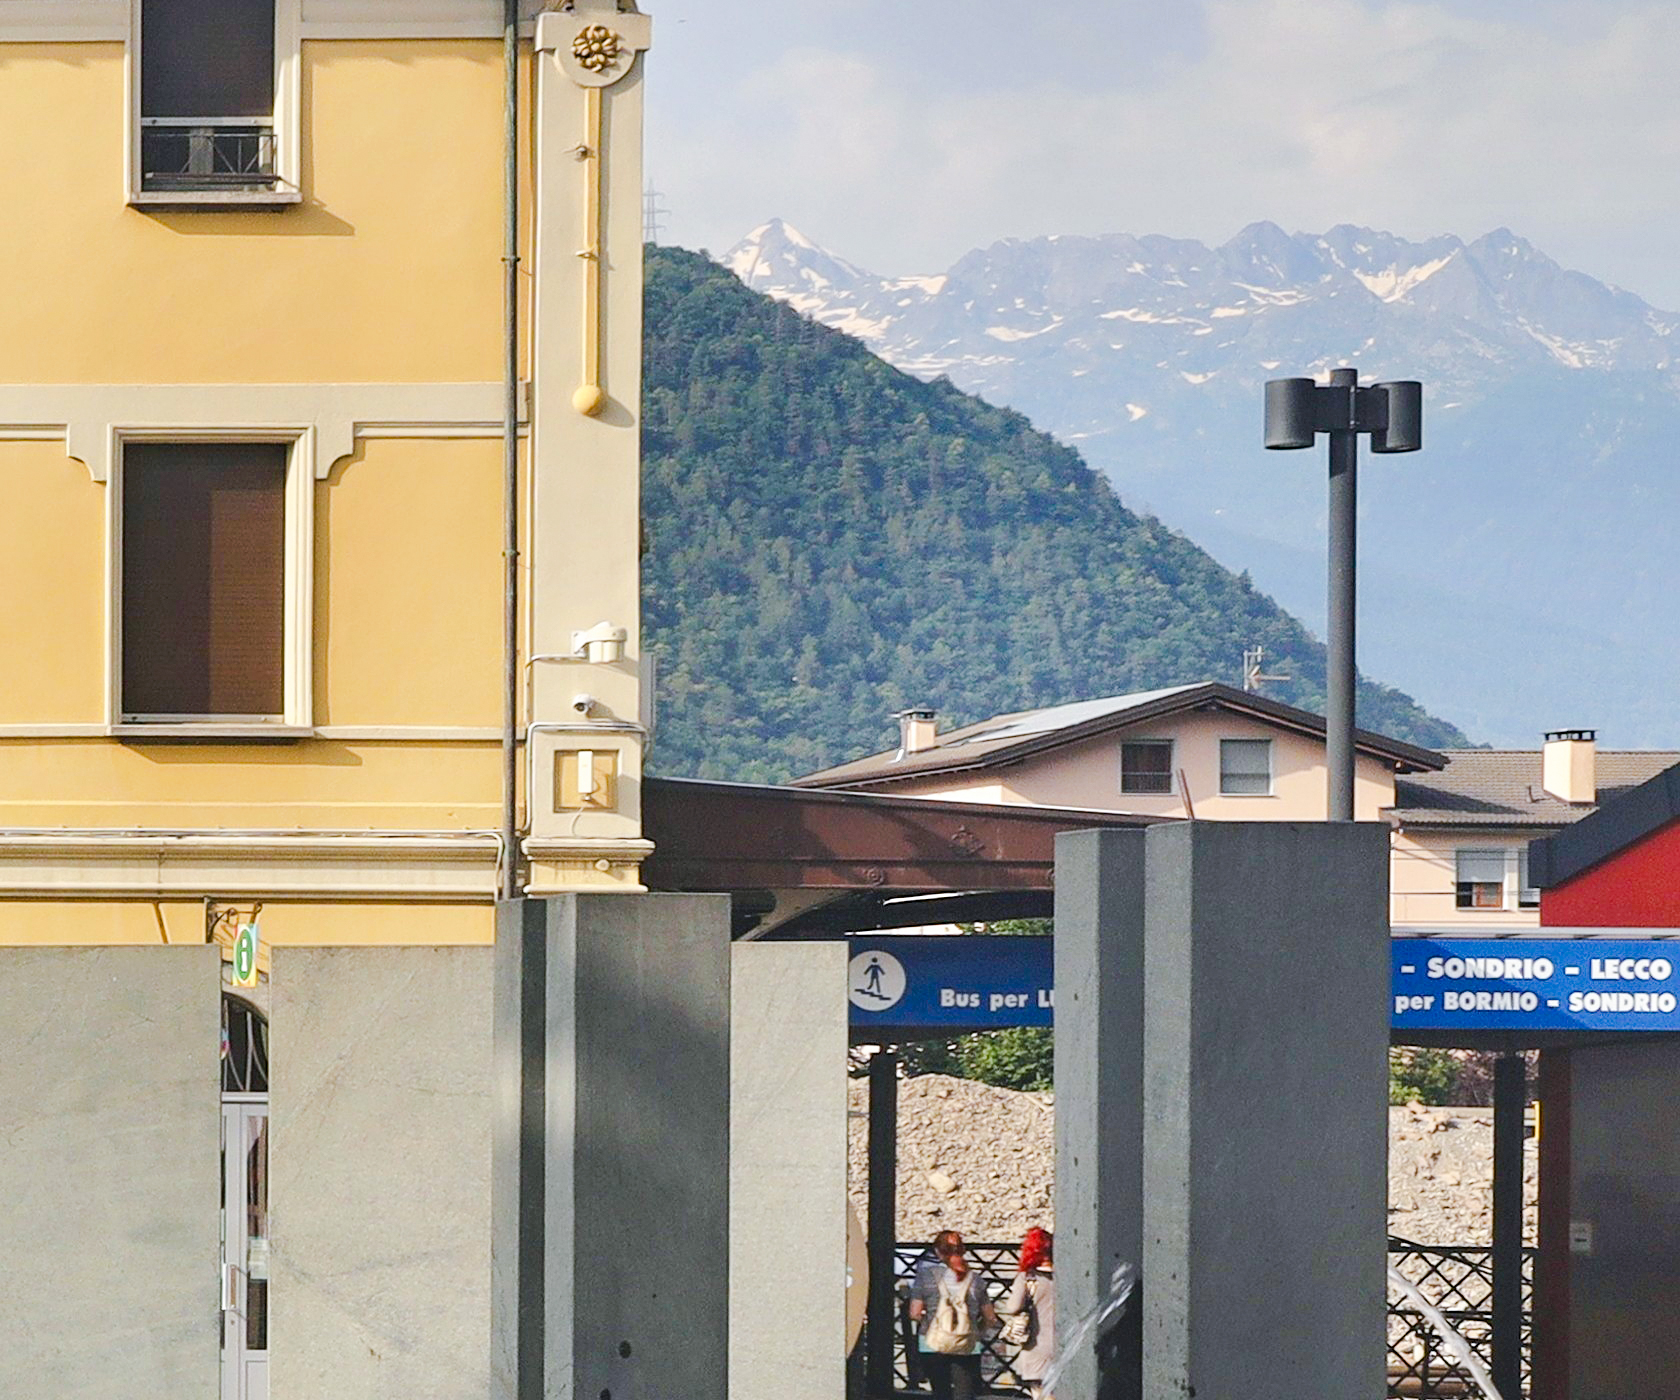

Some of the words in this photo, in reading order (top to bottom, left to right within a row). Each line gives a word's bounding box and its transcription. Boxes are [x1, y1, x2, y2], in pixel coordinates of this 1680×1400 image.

[1426, 957, 1554, 979] SONDRIO
[1591, 958, 1672, 980] LECCO
[940, 988, 980, 1008] Bus
[989, 993, 1028, 1012] per
[1395, 995, 1435, 1014] per
[1443, 991, 1539, 1012] BORMIO
[1568, 991, 1677, 1013] SONDRIO
